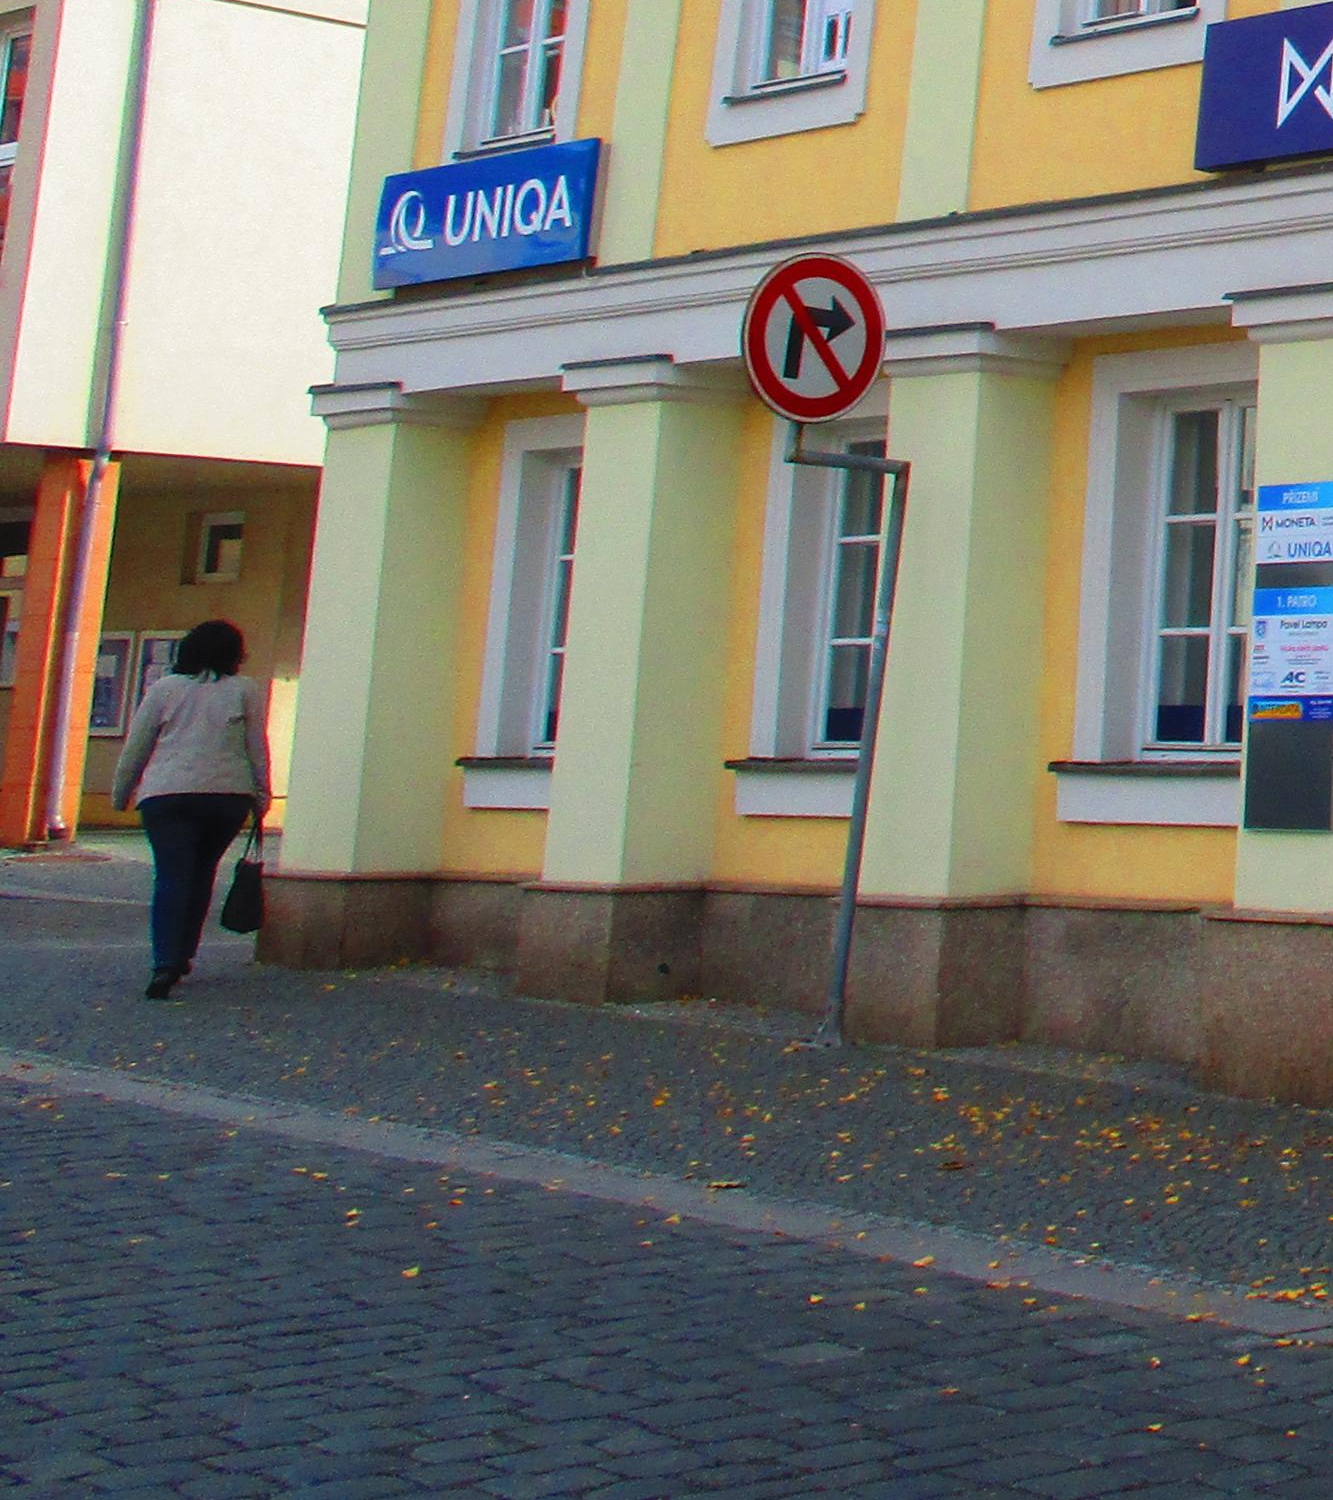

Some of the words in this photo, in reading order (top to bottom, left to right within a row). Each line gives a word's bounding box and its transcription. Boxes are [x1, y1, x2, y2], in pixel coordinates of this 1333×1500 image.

[444, 175, 573, 247] UNIQA
[1276, 516, 1315, 528] MONETA
[1288, 541, 1332, 557] UNIQA
[1280, 620, 1300, 630] Pavel
[1301, 619, 1328, 629] Lampa
